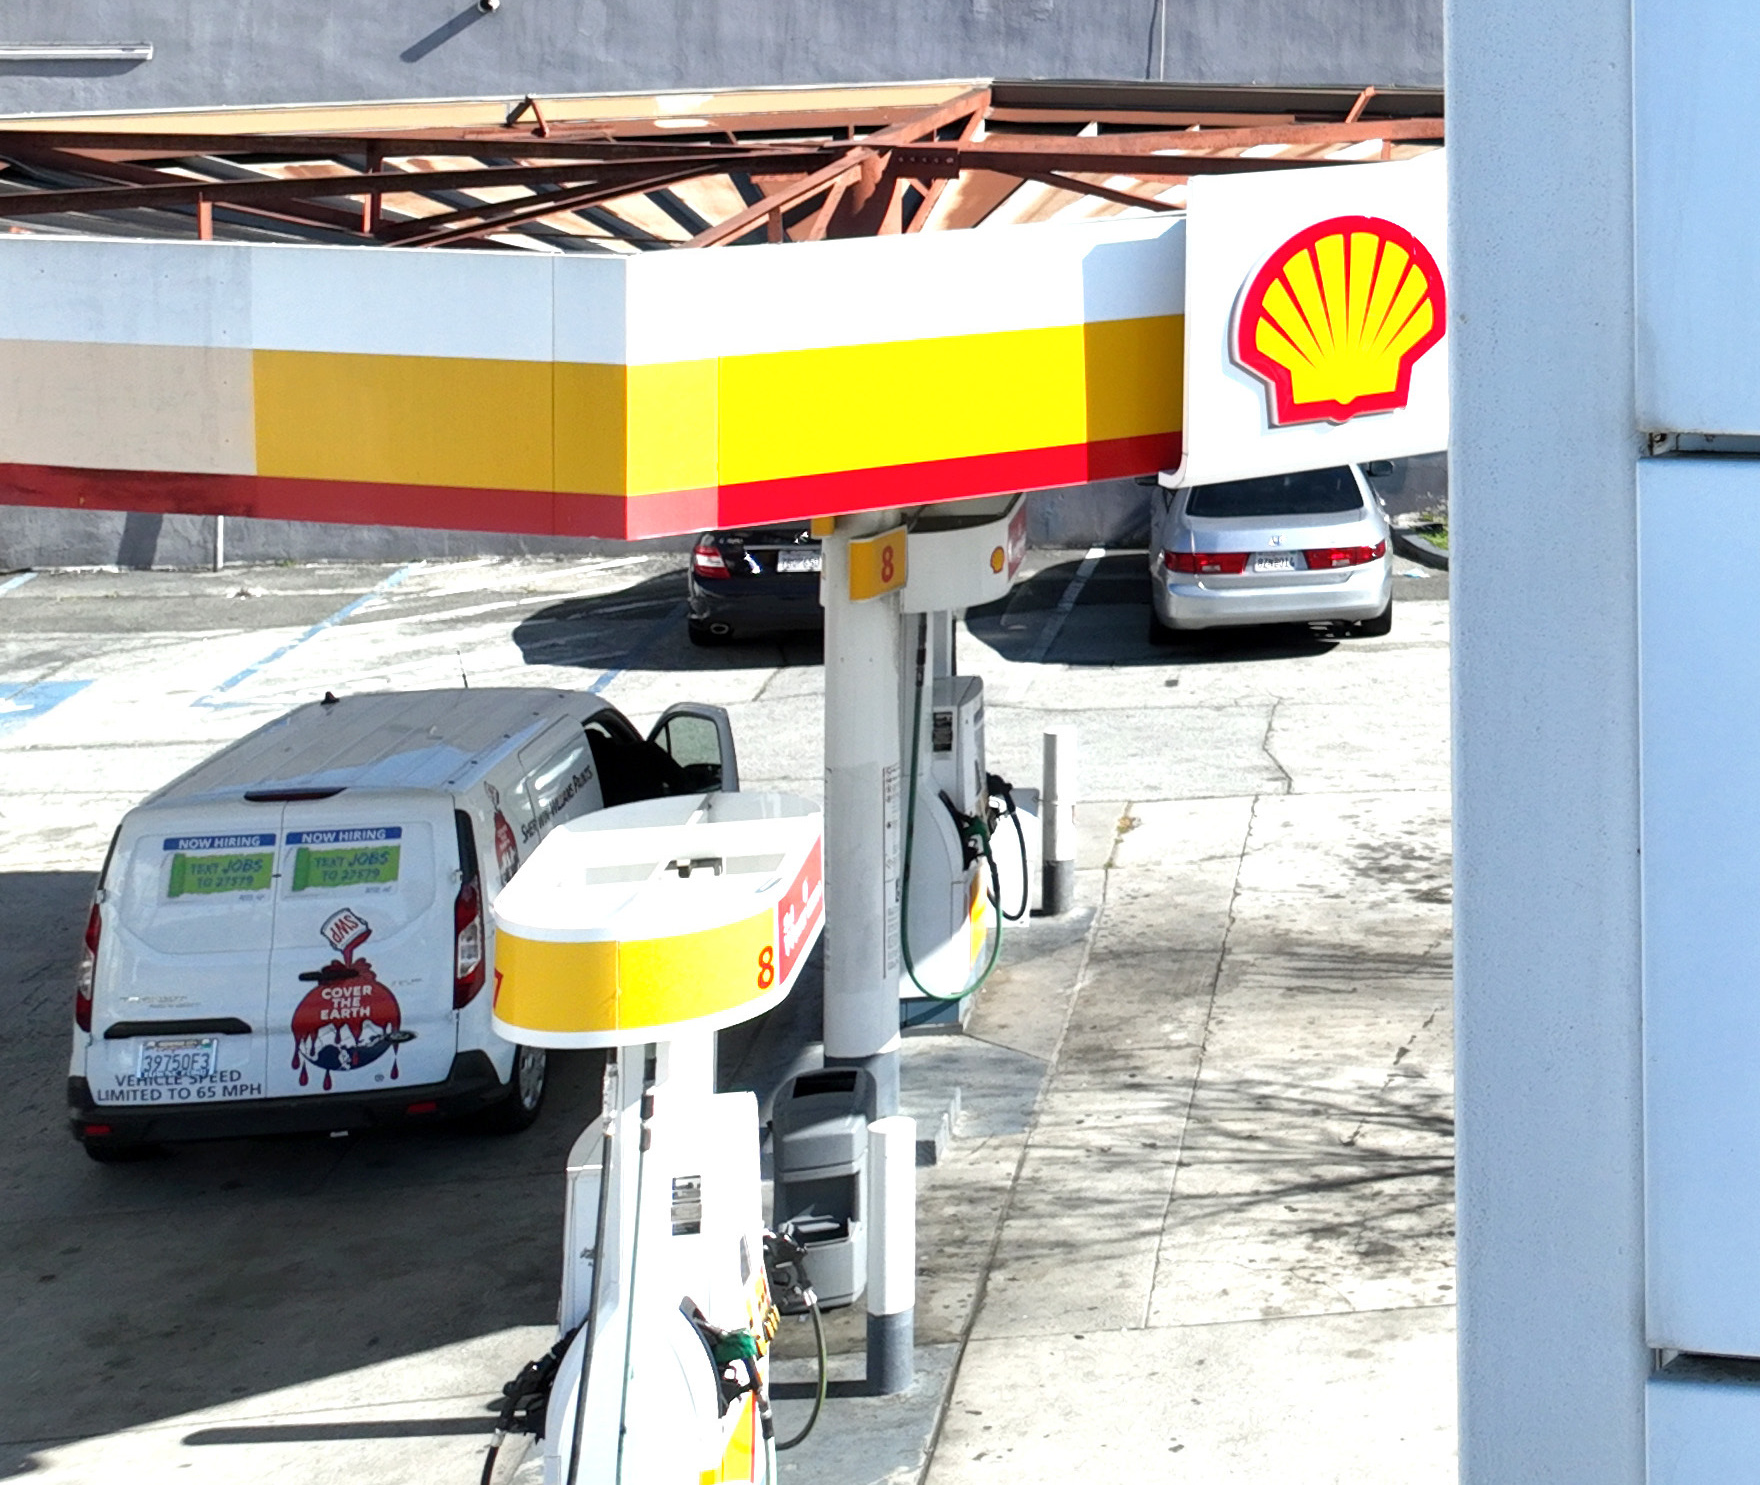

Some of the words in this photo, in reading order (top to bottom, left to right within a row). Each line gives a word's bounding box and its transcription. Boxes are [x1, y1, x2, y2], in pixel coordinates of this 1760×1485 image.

[881, 545, 895, 583] 8
[179, 838, 212, 850] NOW
[214, 836, 261, 848] HIRING
[302, 831, 337, 843] NOW
[339, 829, 386, 842] HIRING
[221, 858, 263, 874] JOBS
[348, 851, 390, 867] JOBS
[322, 870, 338, 881] TO
[329, 914, 360, 945] SWP
[758, 945, 775, 990] 8
[321, 985, 373, 1000] COVER
[332, 996, 361, 1009] THE
[320, 1006, 371, 1020] EARTH
[115, 1073, 182, 1087] VEHICLE
[189, 1070, 241, 1085] SPEED
[97, 1088, 162, 1102] LIMITED
[165, 1087, 191, 1101] TO
[197, 1086, 216, 1099] 65
[222, 1083, 262, 1097] MPH
